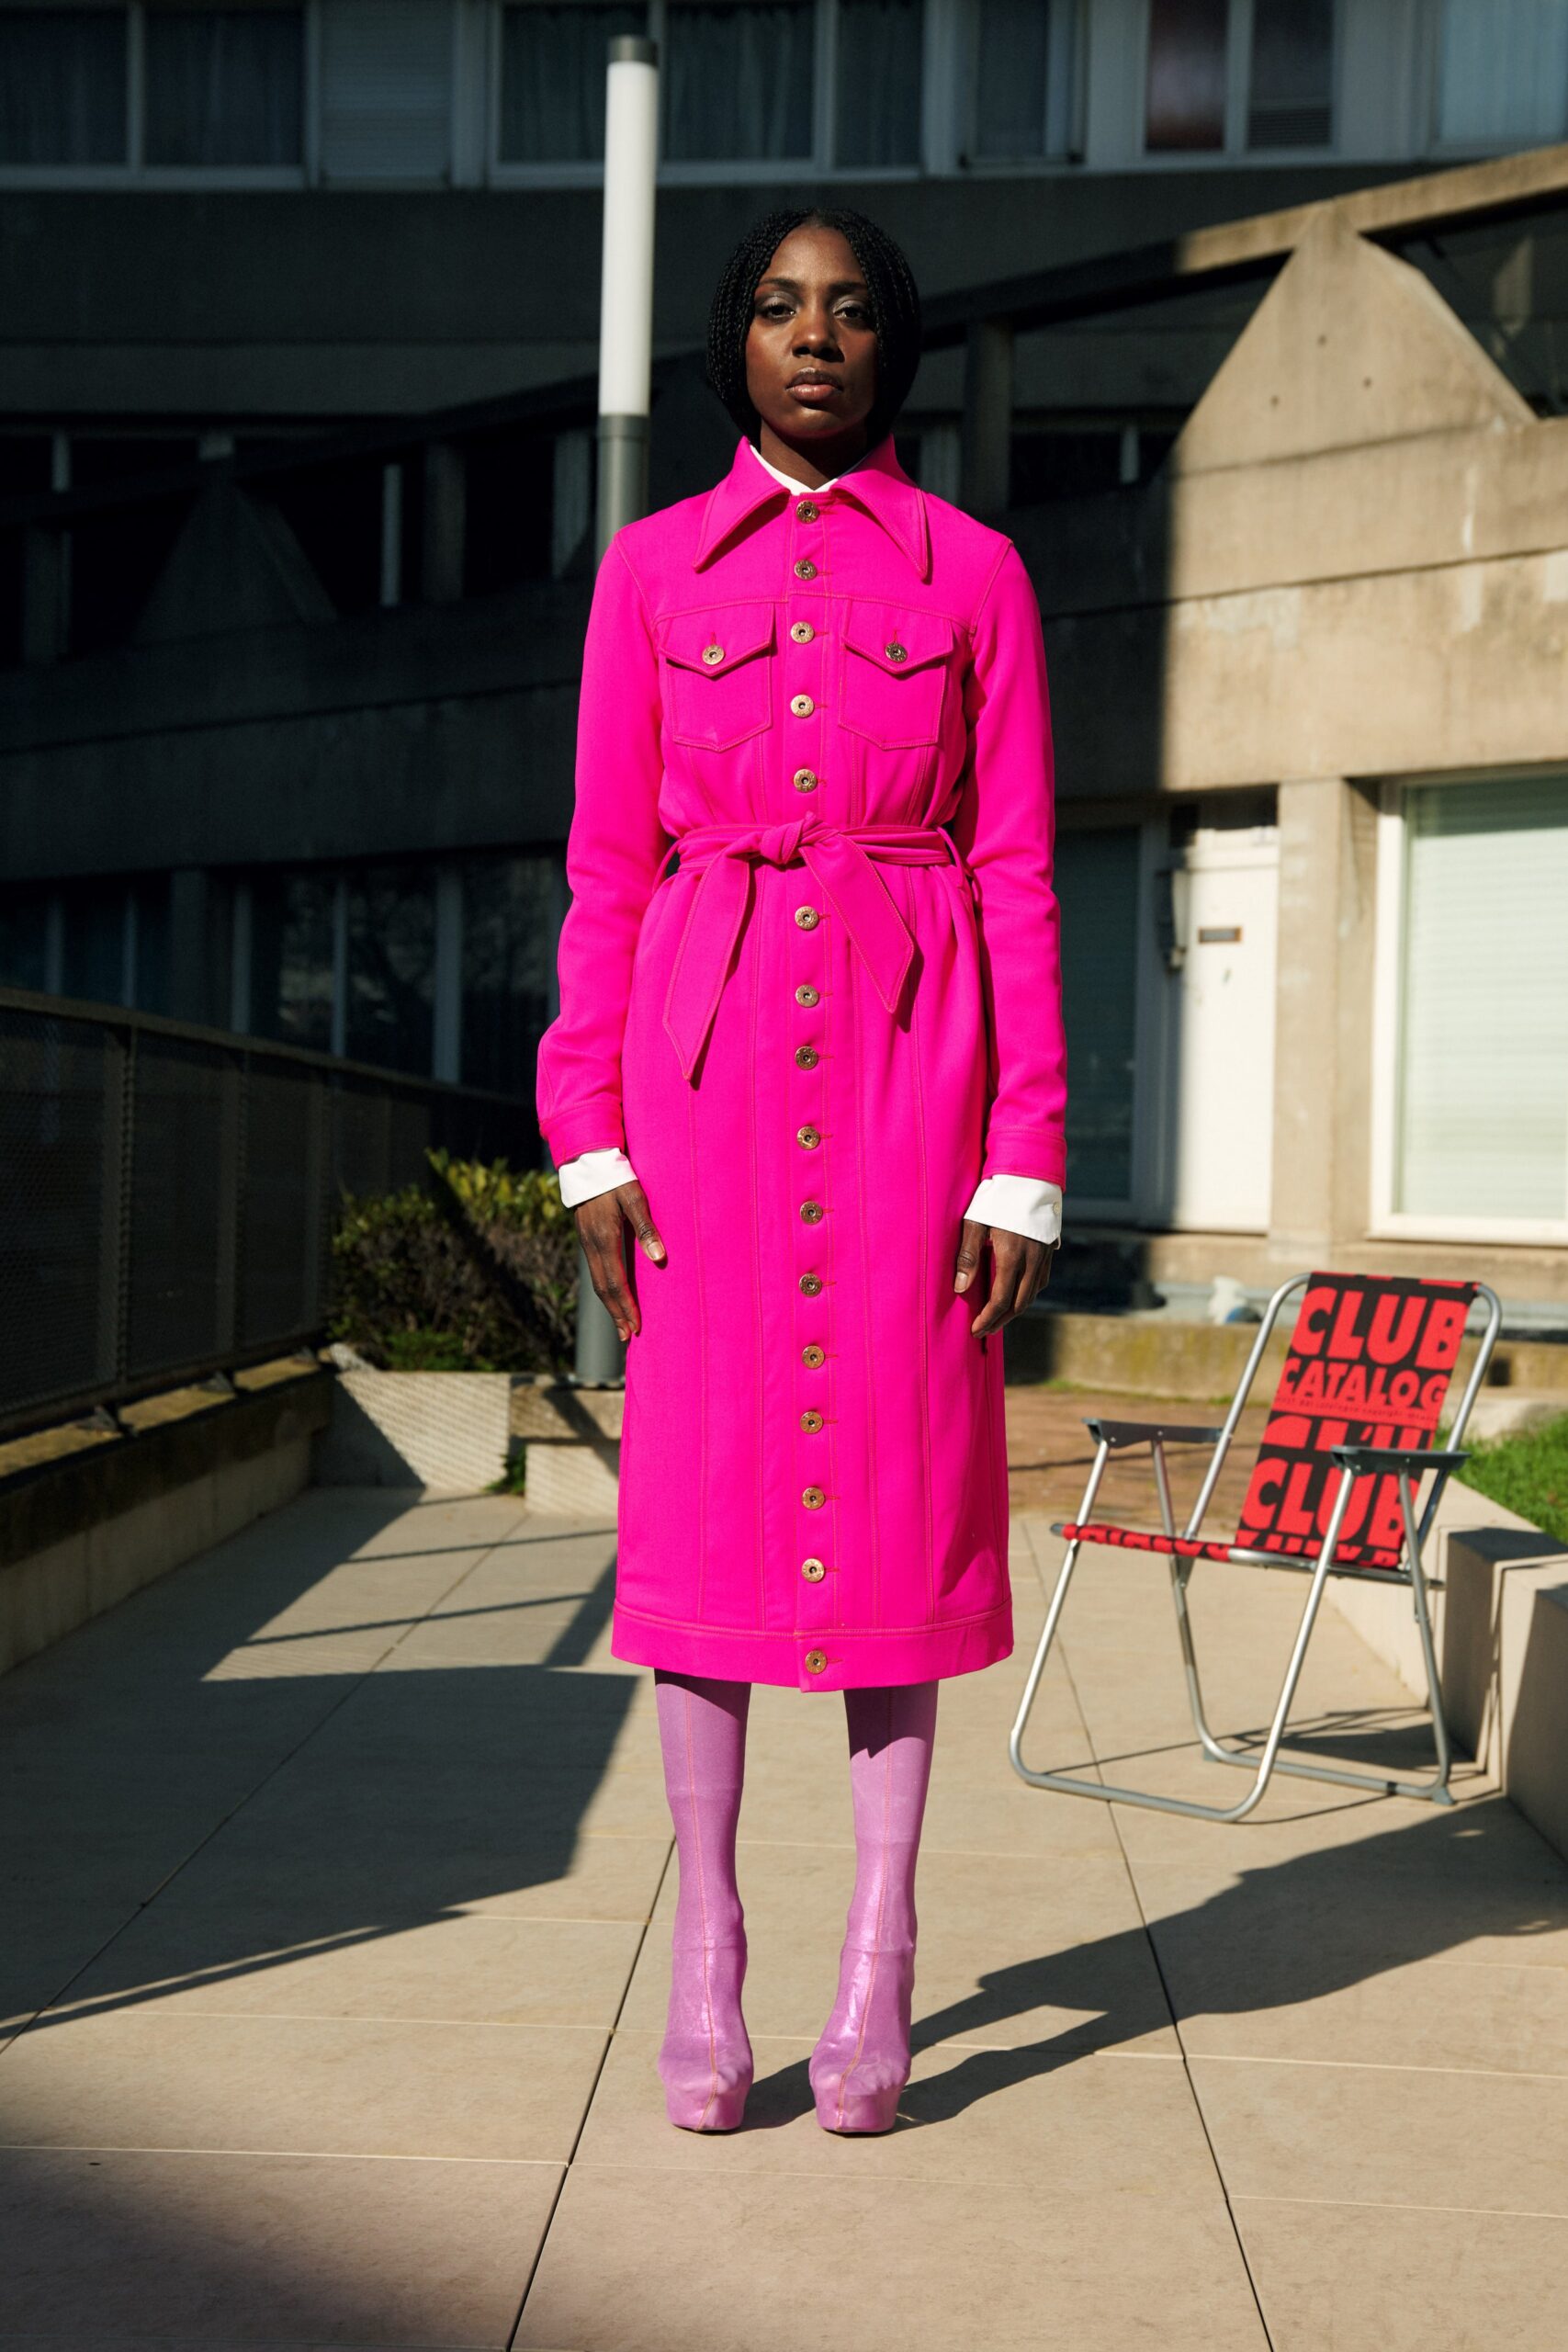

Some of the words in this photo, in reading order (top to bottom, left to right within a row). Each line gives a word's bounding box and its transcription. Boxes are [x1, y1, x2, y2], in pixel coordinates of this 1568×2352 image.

[1291, 1286, 1470, 1371] CLUB
[1276, 1357, 1451, 1409] CATALOG
[1241, 1457, 1420, 1551] CLUB
